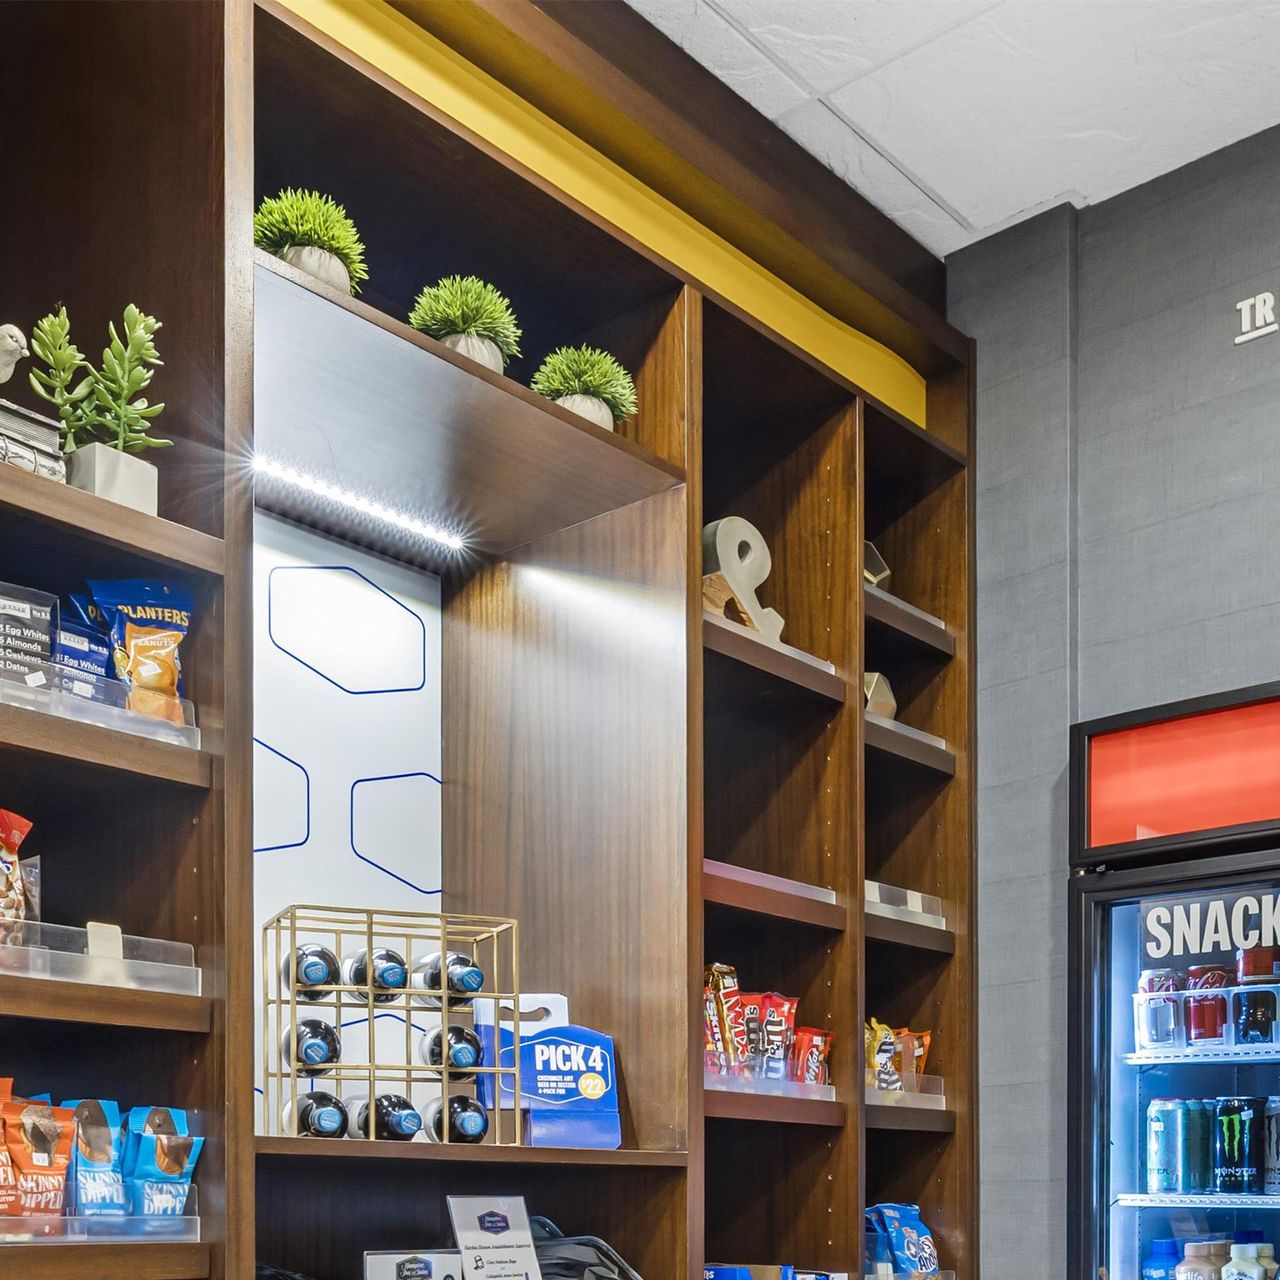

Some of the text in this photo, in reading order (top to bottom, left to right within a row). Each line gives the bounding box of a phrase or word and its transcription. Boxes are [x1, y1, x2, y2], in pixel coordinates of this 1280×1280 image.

[534, 1044, 604, 1071] PICK 4
[580, 1078, 602, 1095] $22
